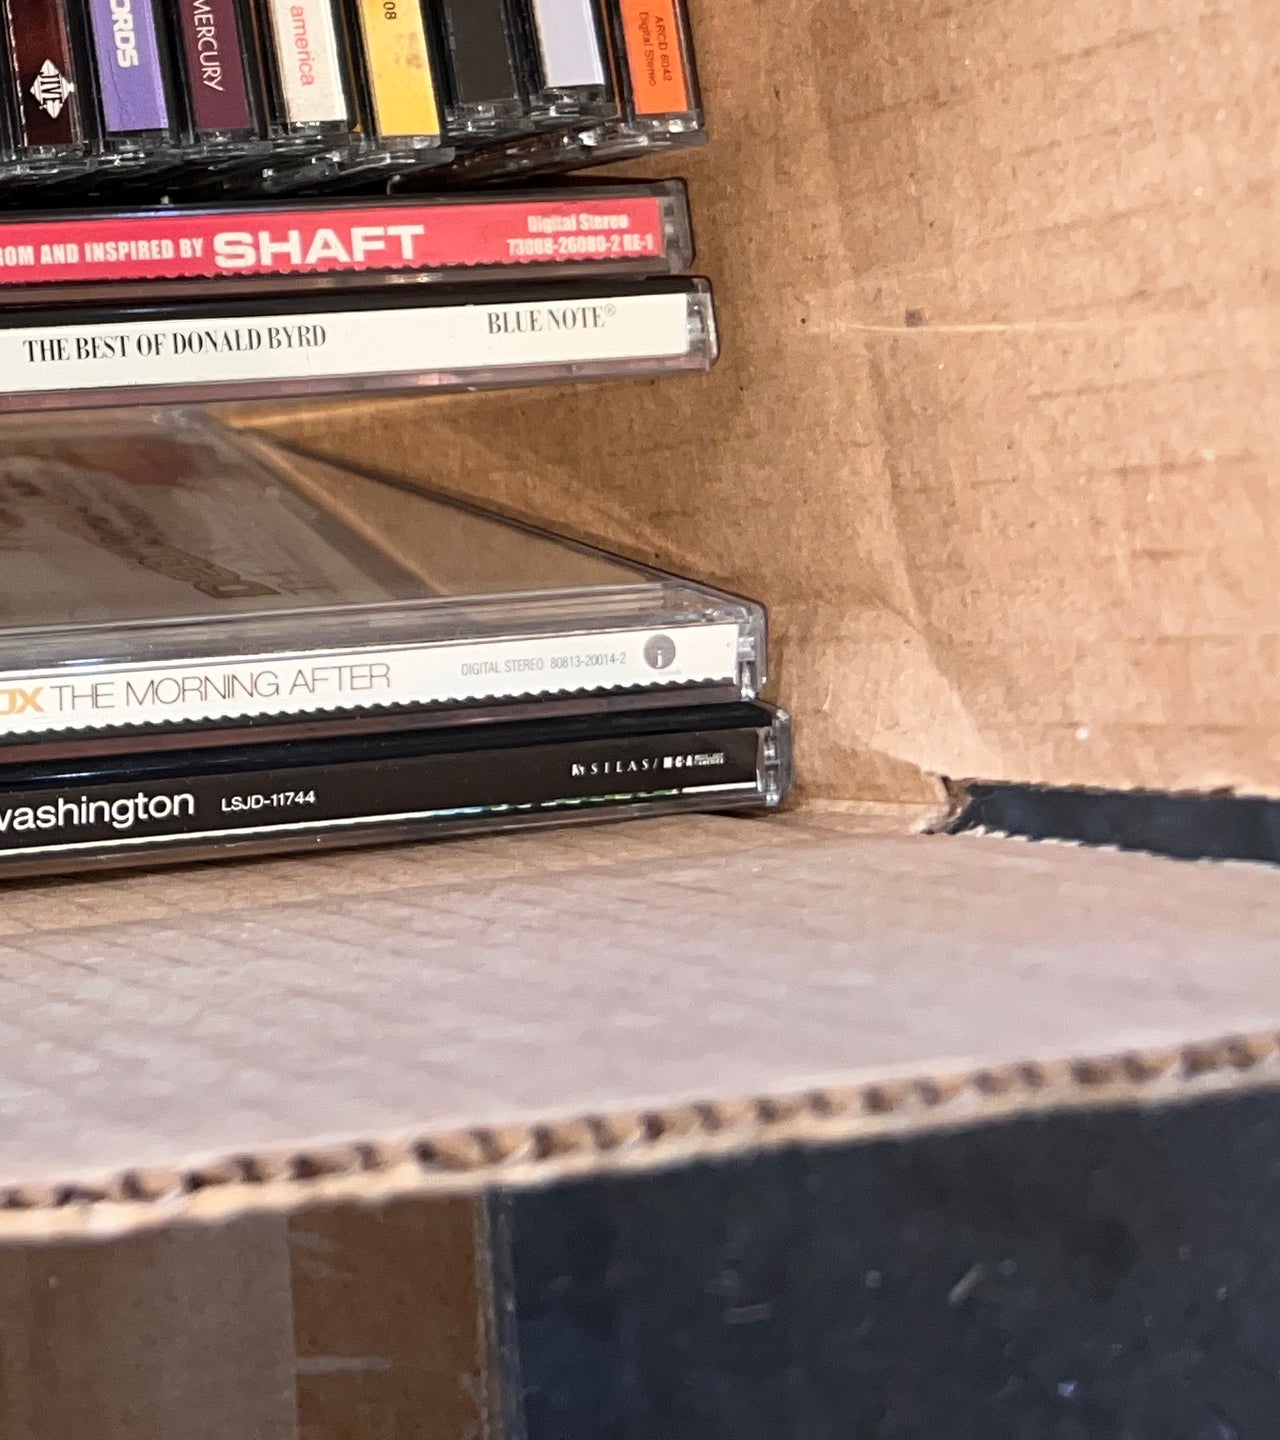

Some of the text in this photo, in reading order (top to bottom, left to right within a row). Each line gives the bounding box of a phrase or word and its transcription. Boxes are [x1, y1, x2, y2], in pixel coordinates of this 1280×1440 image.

[285, 5, 317, 86] america
[35, 70, 63, 106] JIVE
[85, 239, 174, 262] INSPIRED
[213, 225, 424, 269] SHAFT
[76, 325, 326, 359] BEST DONALD BYRD
[126, 670, 279, 706] MORNING
[289, 662, 390, 694] AFTER
[221, 792, 315, 811] LSJD-11744
